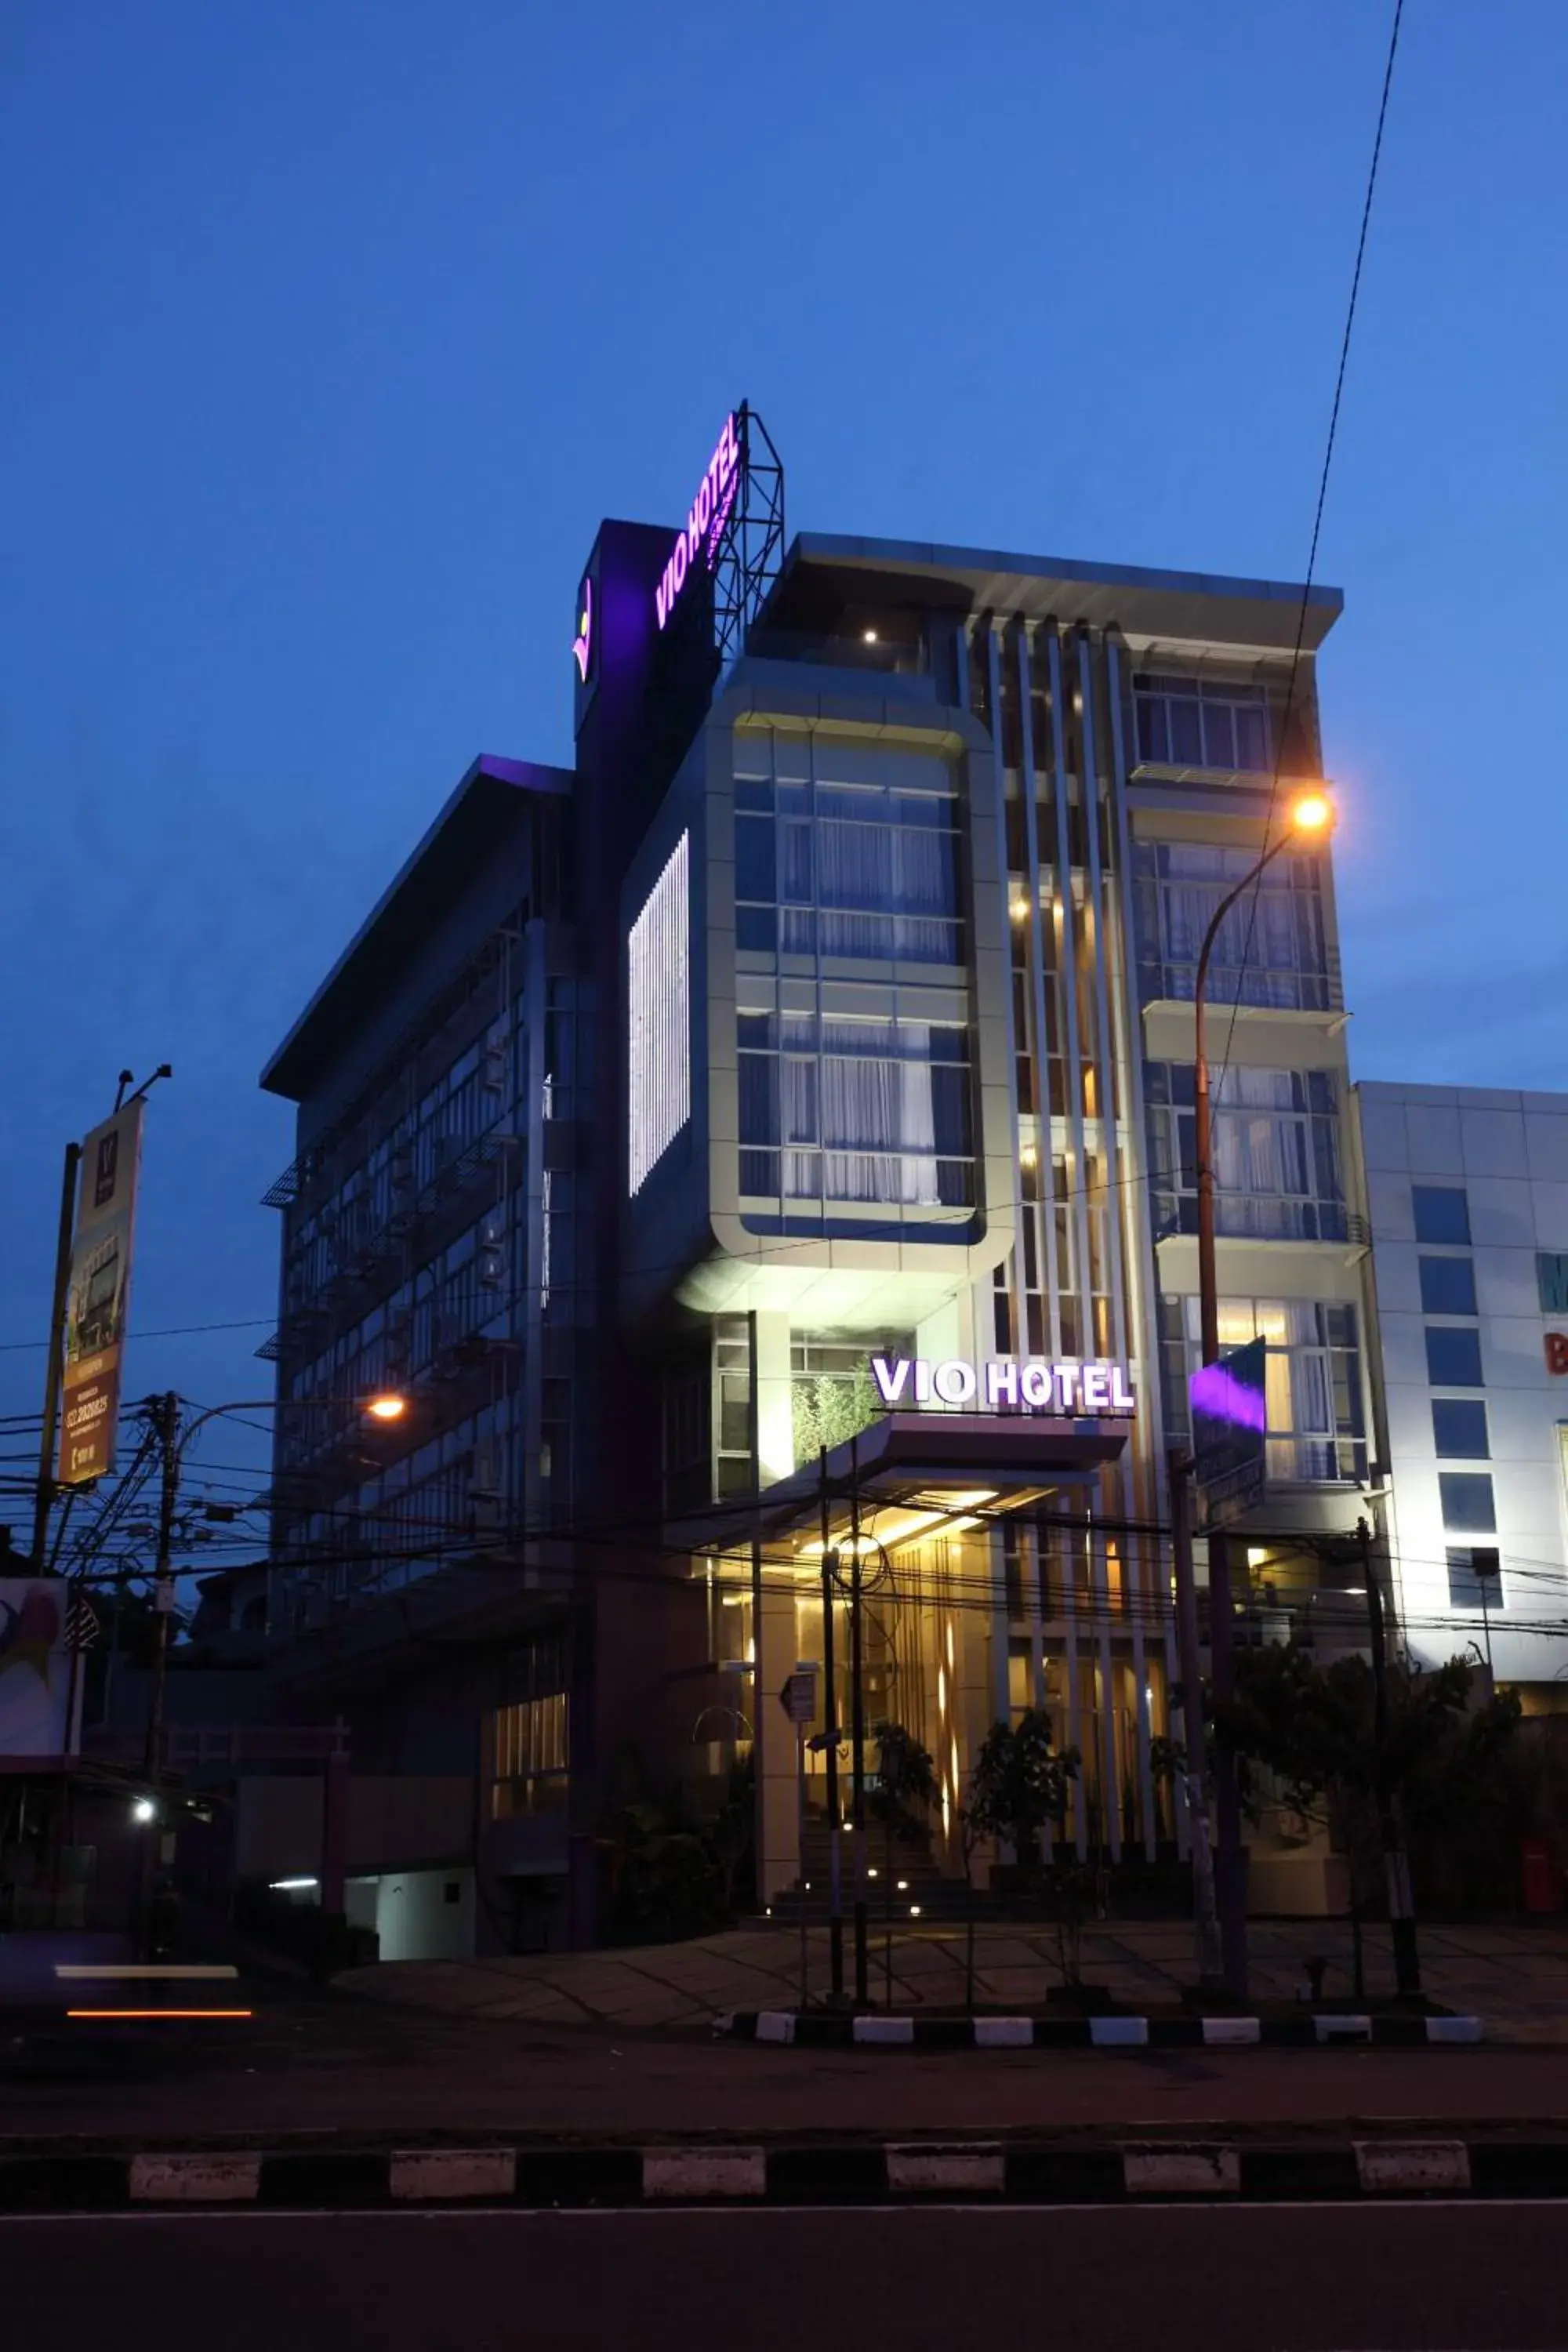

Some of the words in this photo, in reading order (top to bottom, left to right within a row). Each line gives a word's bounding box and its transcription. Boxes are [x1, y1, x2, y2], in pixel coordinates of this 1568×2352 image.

[655, 532, 687, 630] VIO
[688, 412, 739, 564] HOTEL
[872, 1359, 975, 1403] VIO
[986, 1363, 1134, 1407] HOTEL
